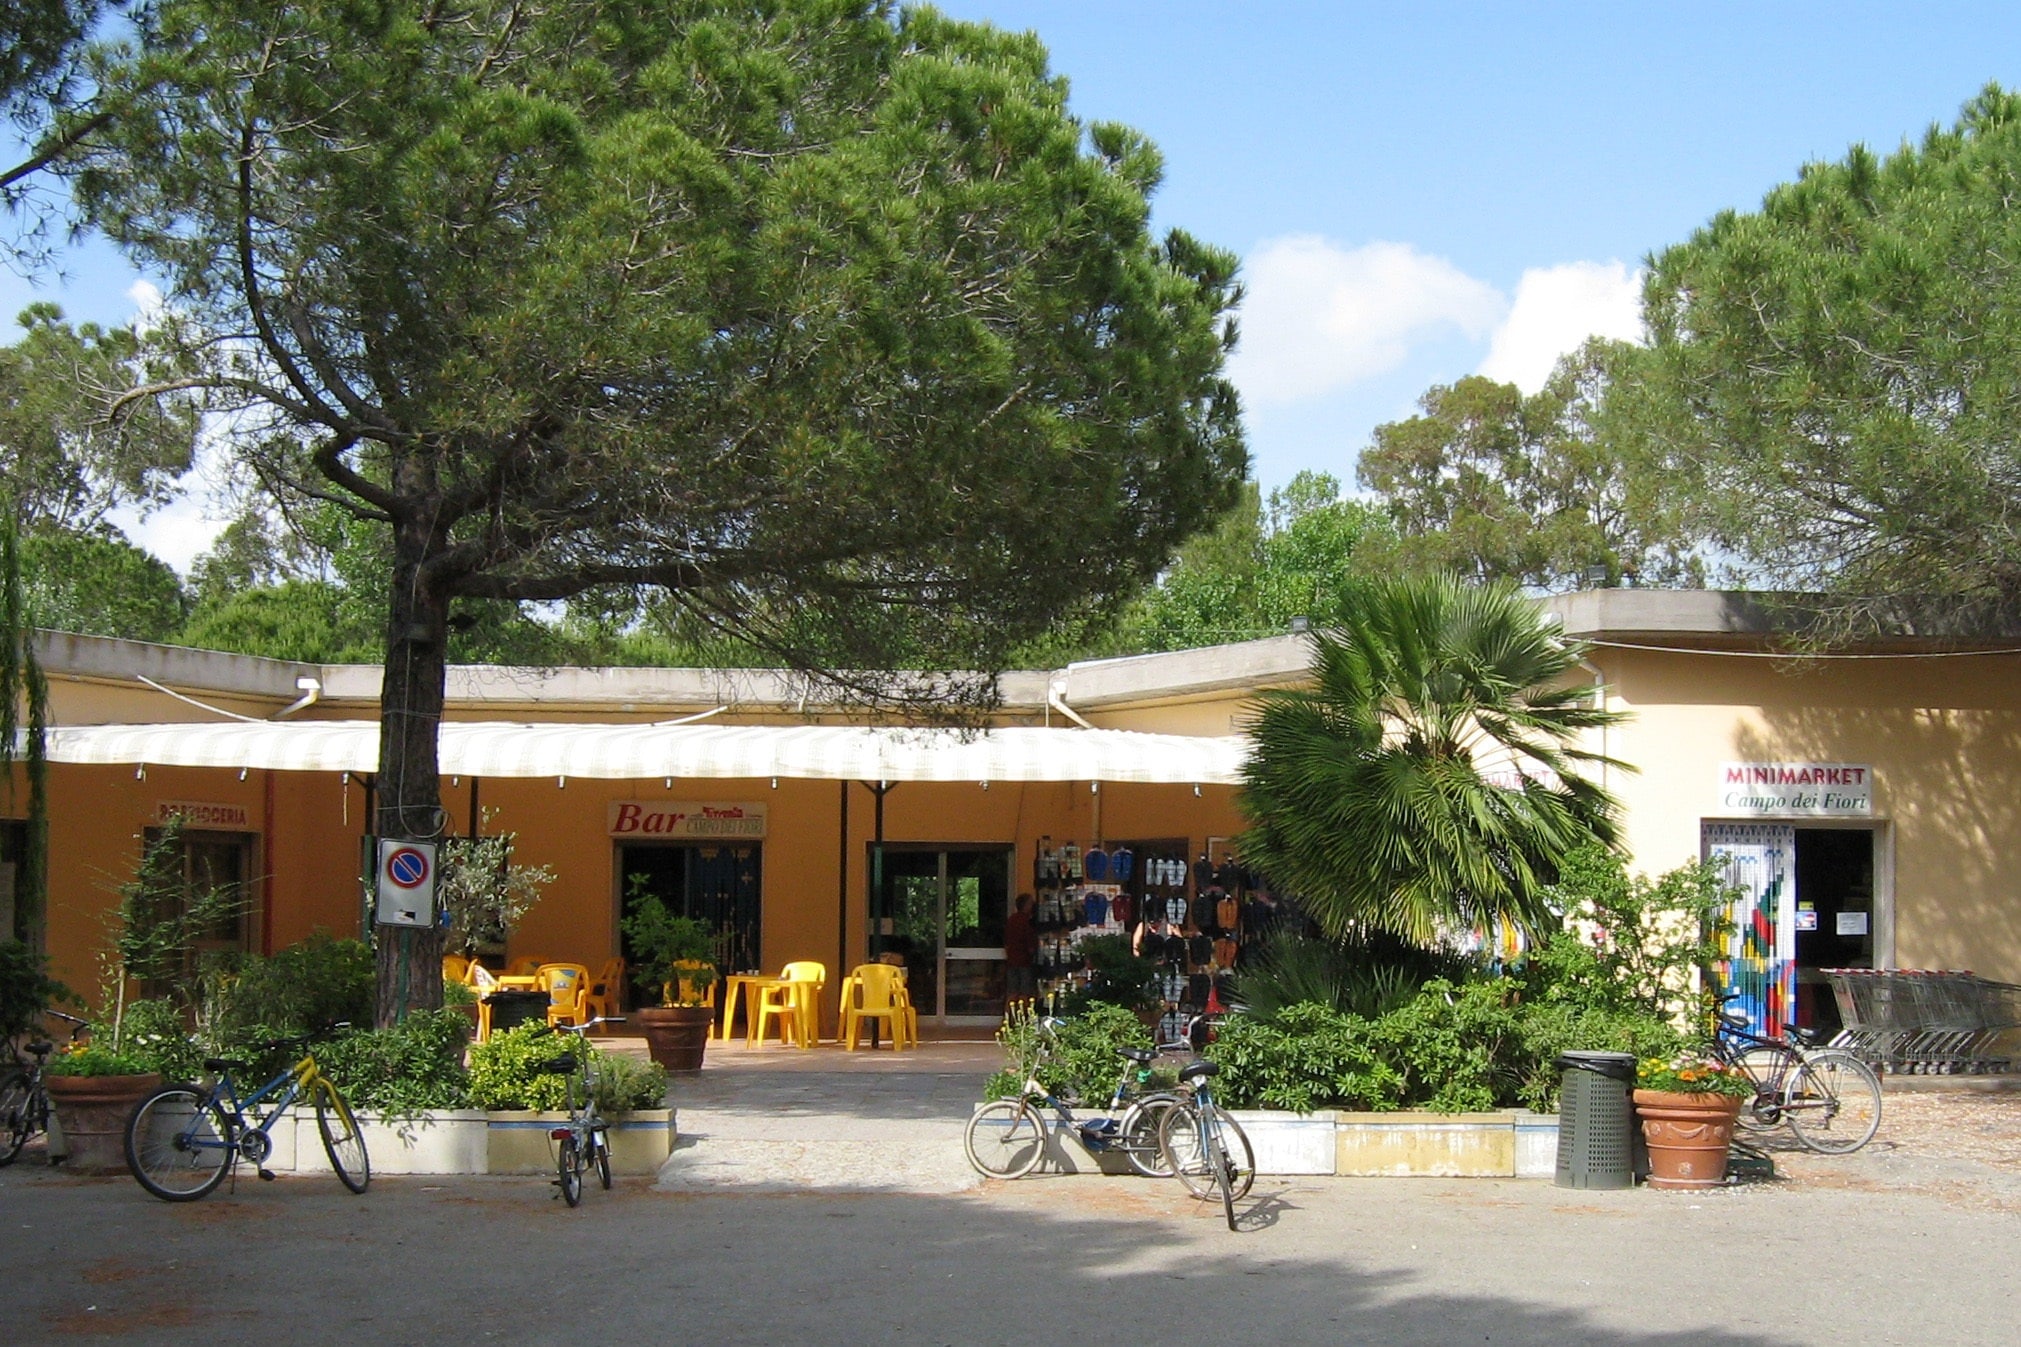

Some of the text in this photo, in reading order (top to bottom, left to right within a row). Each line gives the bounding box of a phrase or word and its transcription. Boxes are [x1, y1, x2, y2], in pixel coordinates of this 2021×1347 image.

[1725, 767, 1865, 785] MINIMARKET
[1725, 791, 1867, 812] Campo dei Fiori
[610, 803, 685, 833] Bar
